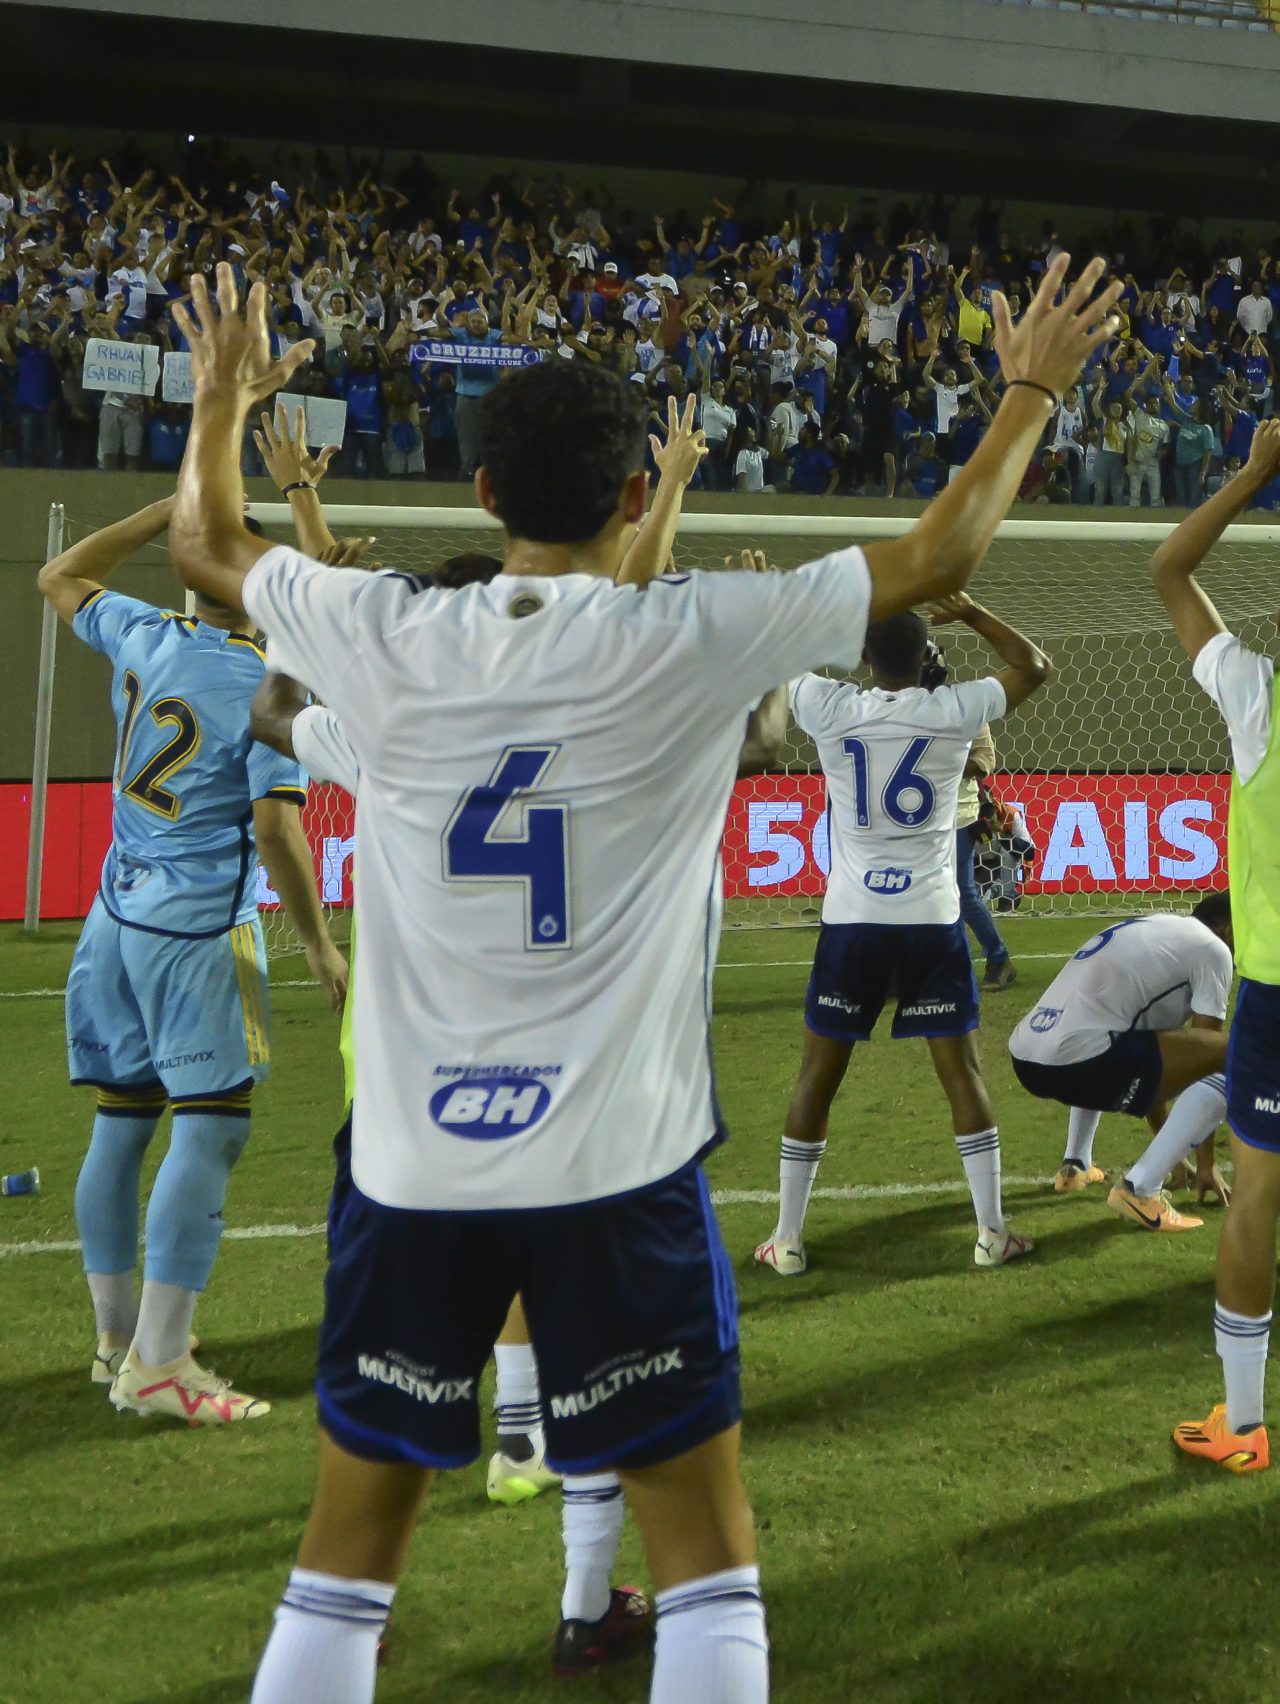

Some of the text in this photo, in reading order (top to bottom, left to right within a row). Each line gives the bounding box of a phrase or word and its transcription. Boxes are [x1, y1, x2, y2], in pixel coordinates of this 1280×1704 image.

[97, 344, 145, 361] RHUAN
[430, 343, 523, 359] CRUZEIRO
[86, 362, 151, 386] GABRIEL
[113, 667, 203, 823] 12
[841, 736, 936, 830] 16
[441, 743, 575, 951] 4
[868, 872, 906, 889] BH
[156, 1050, 215, 1071] MULTIVIX
[438, 1085, 542, 1124] BH
[358, 1353, 474, 1404] MULTIVIX
[550, 1347, 684, 1419] MULTIVIX
